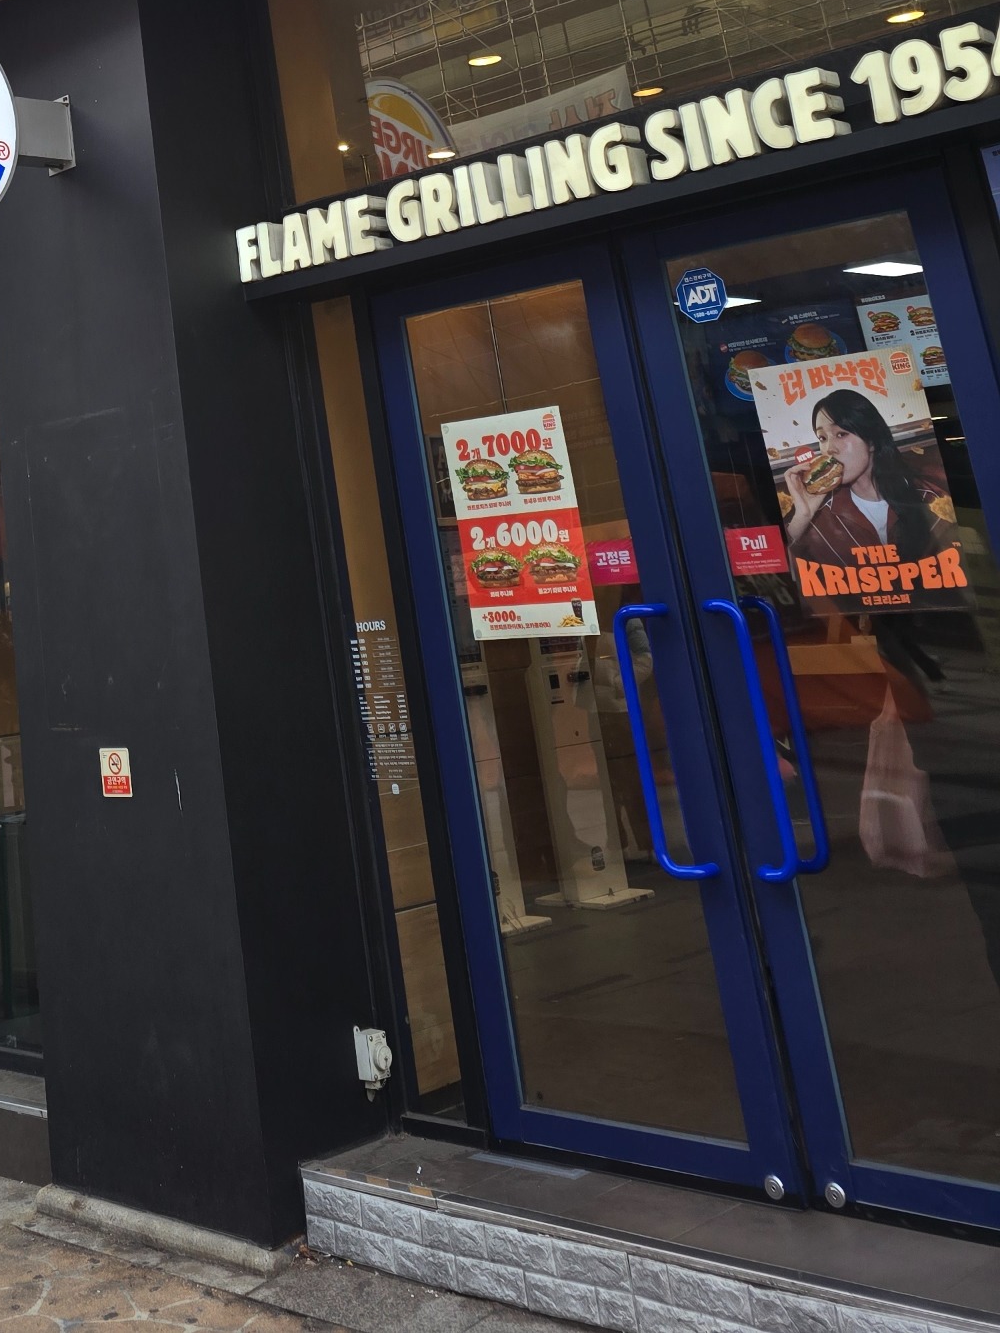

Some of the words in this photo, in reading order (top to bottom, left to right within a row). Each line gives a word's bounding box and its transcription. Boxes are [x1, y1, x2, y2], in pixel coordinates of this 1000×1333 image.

[235, 195, 392, 283] FLAME
[385, 122, 649, 243] GRILLING
[645, 67, 852, 181] SINCE
[687, 283, 718, 307] ADT
[891, 363, 911, 371] KING
[778, 368, 806, 406] 더
[809, 357, 889, 397] 바삭한
[470, 527, 496, 550] 2개
[740, 535, 768, 550] Pull
[595, 550, 632, 566] 고정문
[851, 543, 900, 565] THE
[796, 546, 968, 598] KRISPPER
[862, 596, 873, 606] 더
[874, 593, 911, 605] 크리스퍼
[356, 620, 386, 633] HOURS
